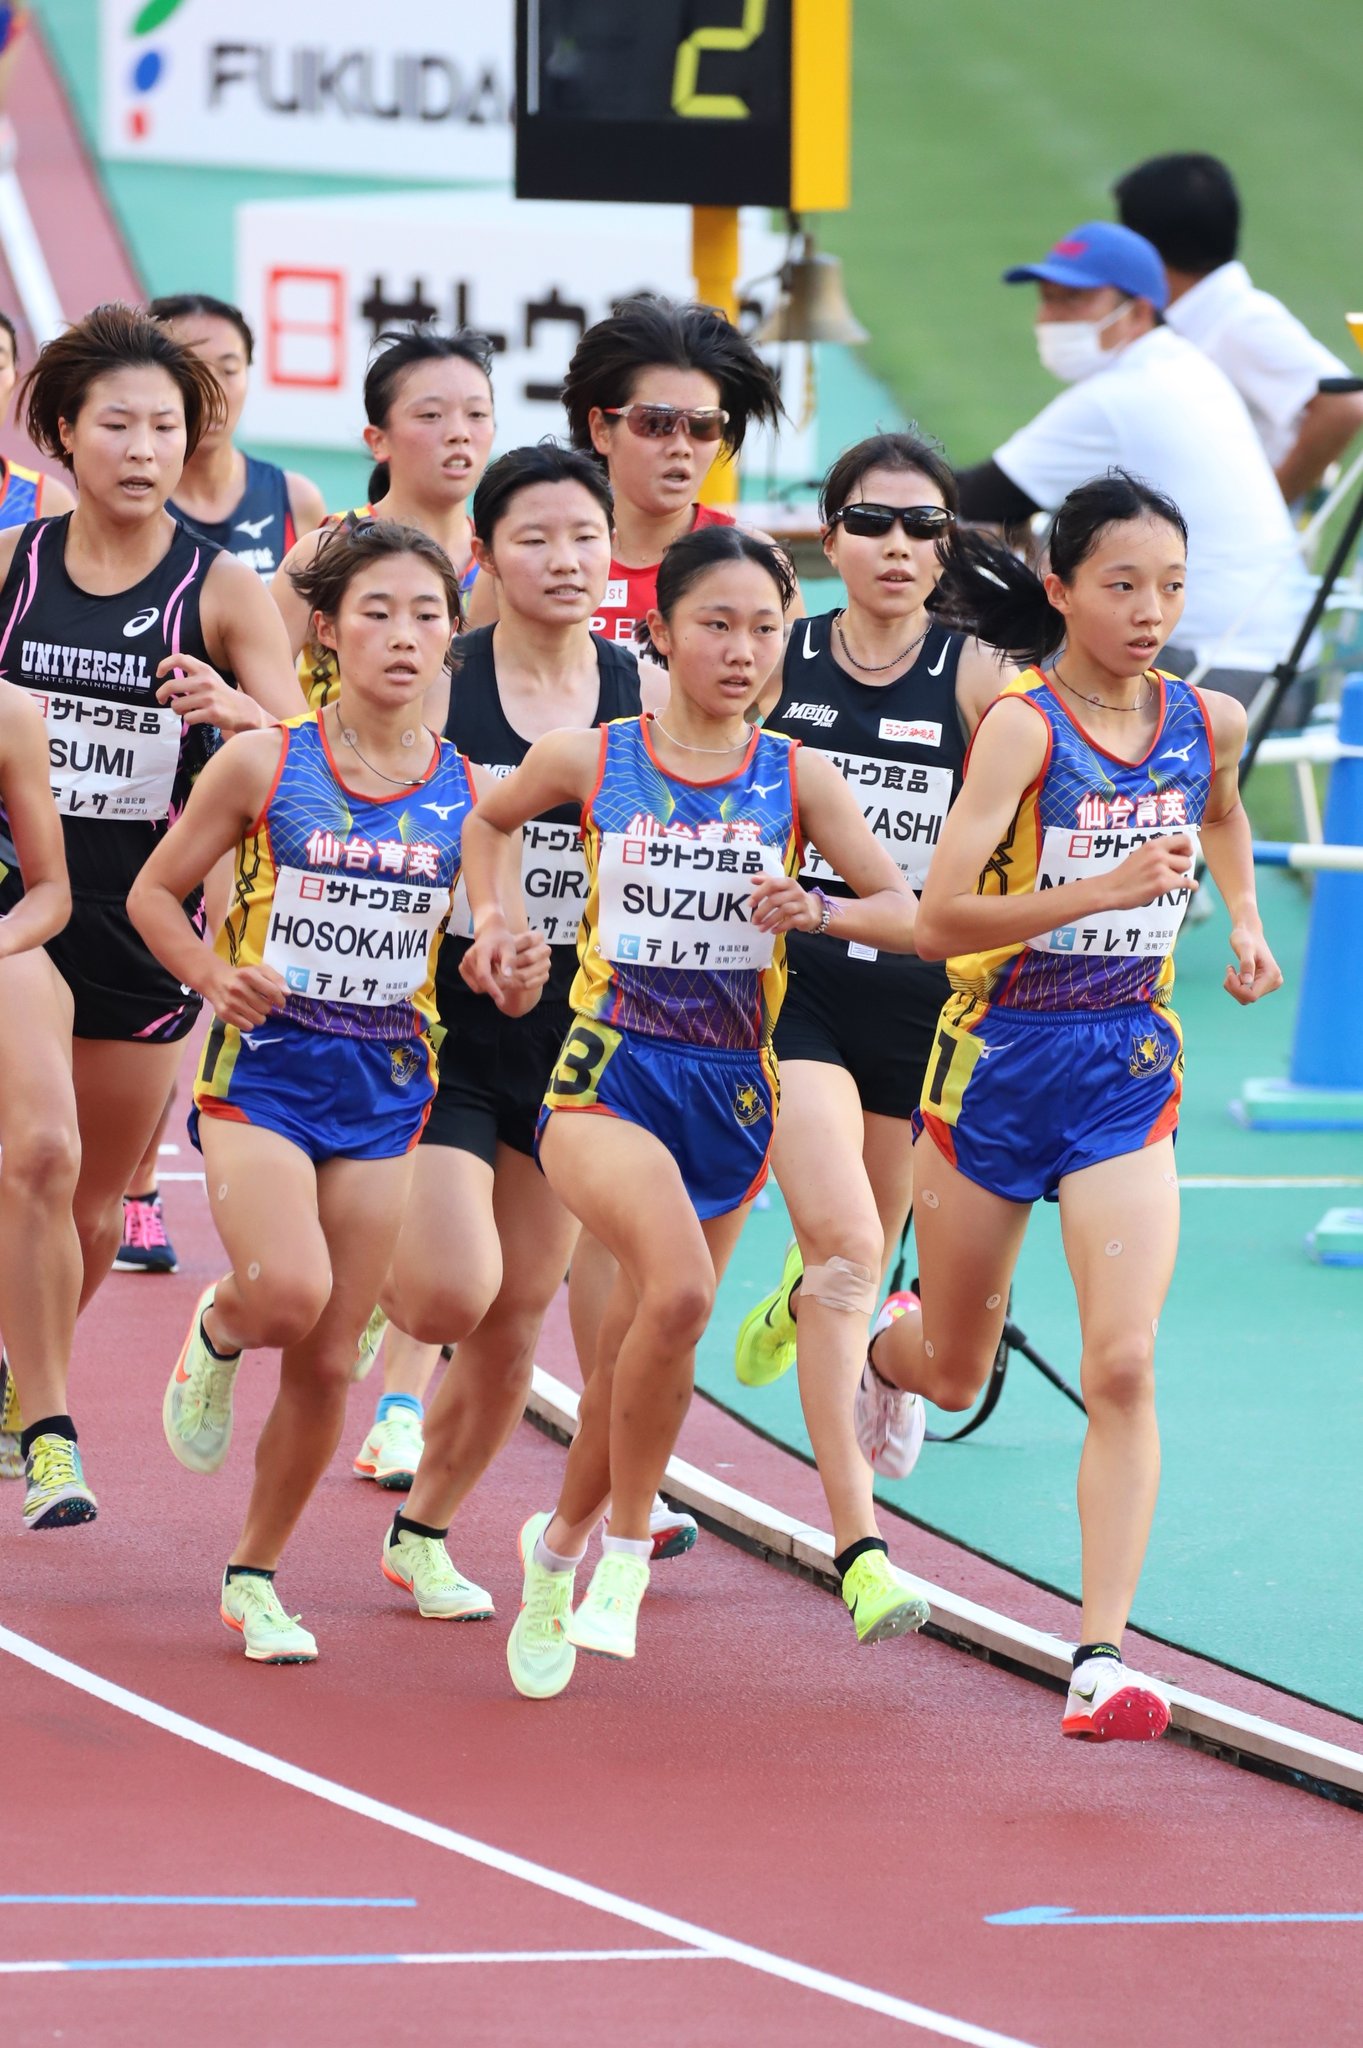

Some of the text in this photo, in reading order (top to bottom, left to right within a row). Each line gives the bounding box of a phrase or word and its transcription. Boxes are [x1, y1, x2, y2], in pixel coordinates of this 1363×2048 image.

[208, 42, 512, 126] FUKUDA
[21, 640, 151, 688] UNIVERSAL
[35, 674, 133, 693] ENTERTAINMENT
[51, 697, 161, 735] サトウ食品
[782, 702, 839, 727] Meijo
[49, 738, 135, 778] SUMI
[1076, 791, 1187, 830] 仙台育英
[306, 829, 440, 880] 仙台育英
[648, 842, 764, 874] サトウ食品
[326, 881, 431, 914] サトウ食品
[525, 868, 591, 899] GIR
[622, 883, 757, 922] SUZUK
[271, 912, 428, 960] HOSOKAWA
[646, 938, 710, 965] テレサ
[1082, 928, 1141, 952] テレサ
[316, 972, 378, 1001] テレサ
[547, 1026, 605, 1096] 3
